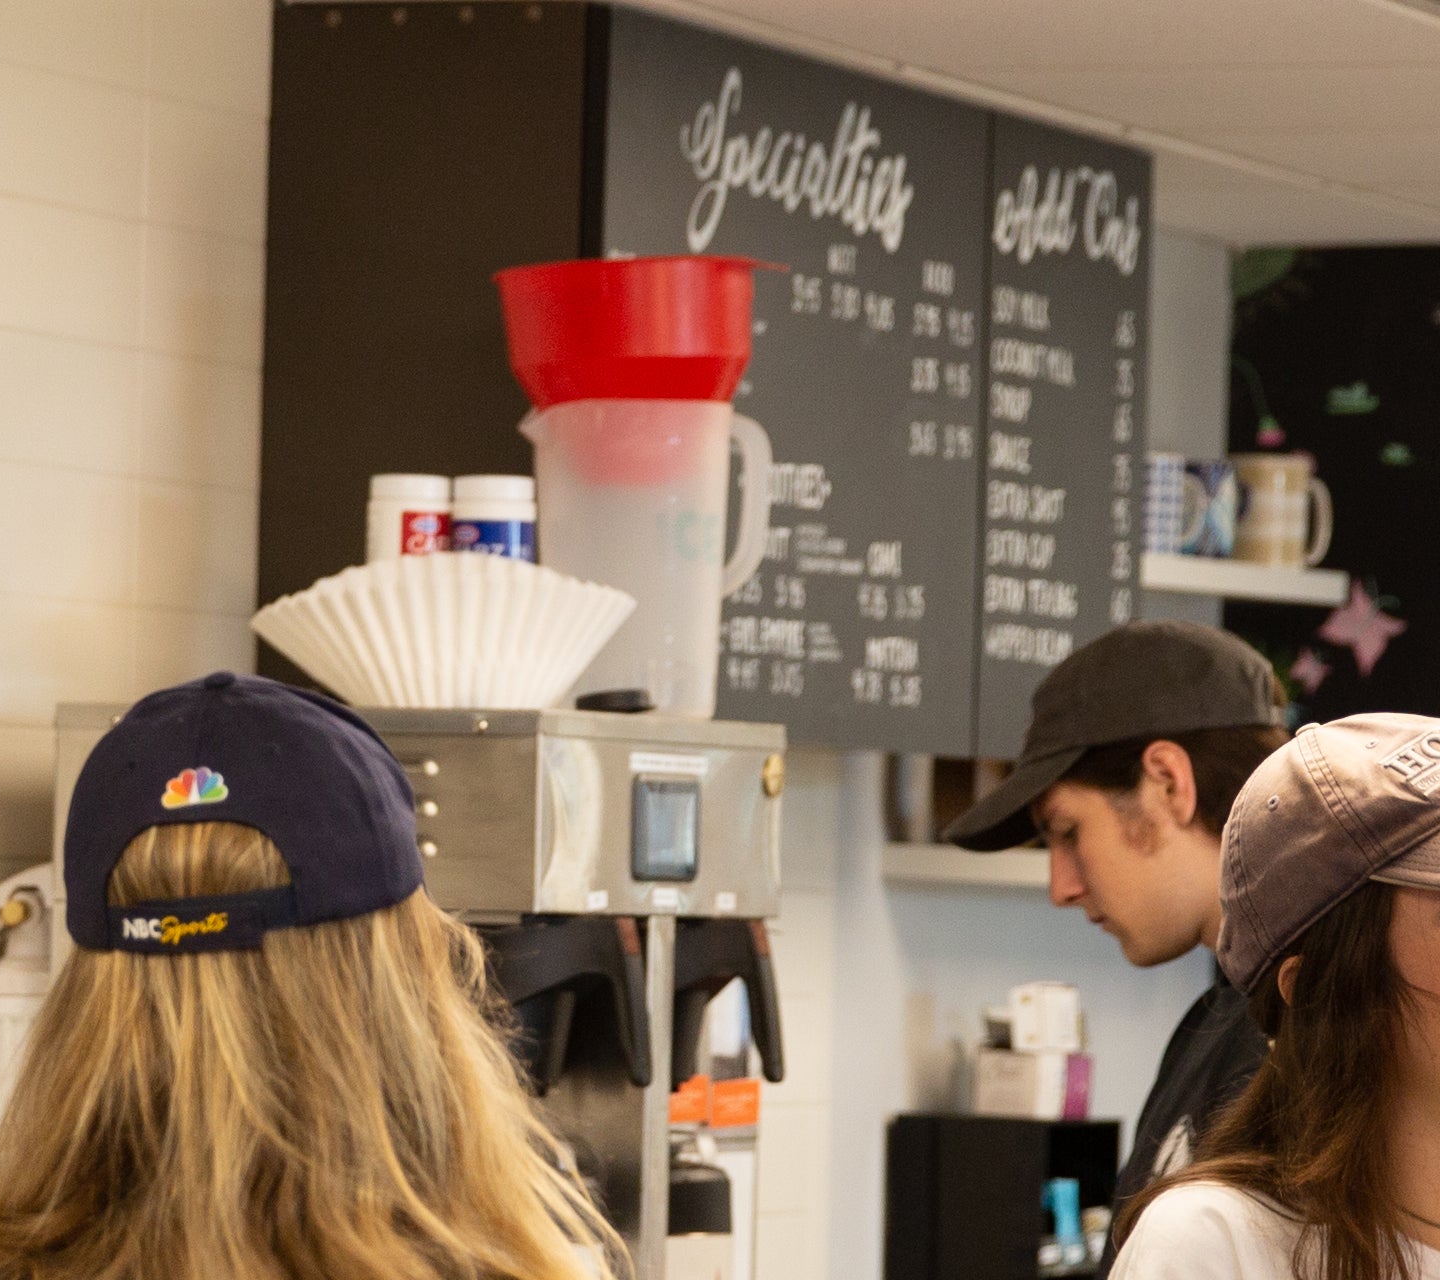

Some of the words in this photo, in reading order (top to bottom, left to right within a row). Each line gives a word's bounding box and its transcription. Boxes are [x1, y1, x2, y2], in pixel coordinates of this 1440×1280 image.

[681, 67, 913, 253] Specialties
[123, 918, 161, 939] NBC
[161, 912, 228, 945] Sports
